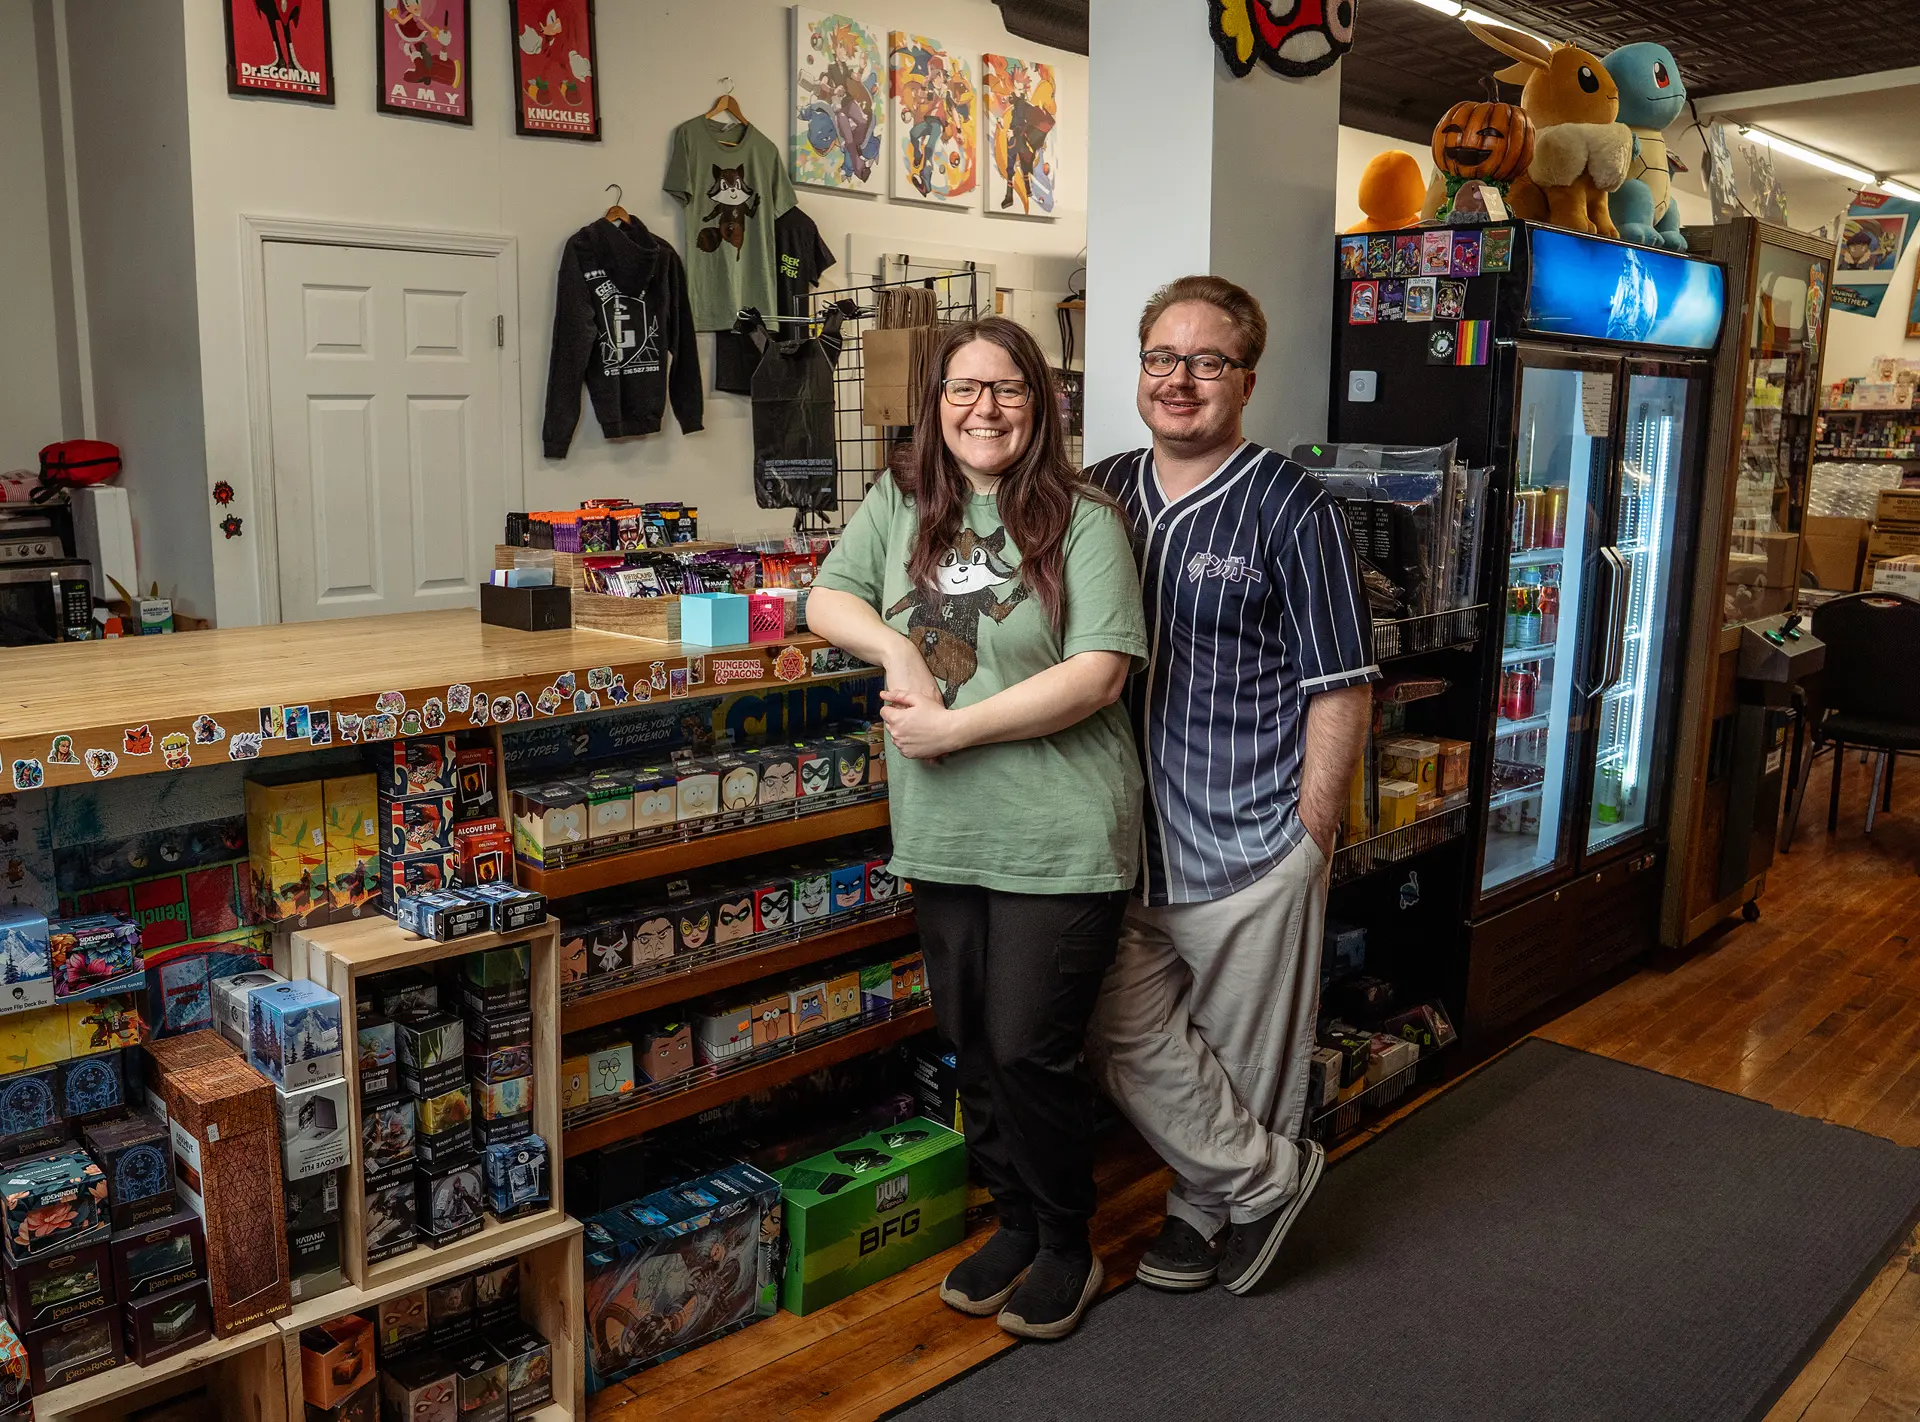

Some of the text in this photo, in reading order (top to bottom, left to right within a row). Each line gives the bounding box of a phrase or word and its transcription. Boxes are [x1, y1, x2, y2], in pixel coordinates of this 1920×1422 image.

[241, 62, 320, 84] Dr.EGGMAN
[242, 78, 320, 92] EVIL GENIUS
[391, 84, 460, 105] AMY
[527, 107, 591, 124] KNUCKLES
[1832, 288, 1857, 299] OURNEY
[1832, 295, 1869, 308] TOGETHER
[713, 660, 761, 671] DUNGEONS
[723, 669, 764, 679] DRAGONS
[609, 715, 677, 737] CHOOSE YOUR
[573, 733, 590, 757] 2
[613, 738, 624, 748] 21
[503, 743, 560, 762] RGY TYPES
[457, 823, 497, 835] ALCOVE FLIP
[134, 902, 188, 930] Bench
[79, 932, 115, 944] SIDEWINDER
[106, 981, 144, 992] ULTIMATE GUARD
[13, 1004, 23, 1012] Flip
[24, 1001, 38, 1009] Deck
[293, 1080, 309, 1088] Alcove
[316, 1075, 327, 1083] Deck
[39, 1136, 61, 1146] RINGS
[299, 1155, 344, 1173] ALCOVE FLIP
[41, 1187, 78, 1201] SIDEWINDER
[876, 1172, 909, 1207] DOOM
[152, 1204, 172, 1214] RINGS
[295, 1231, 326, 1245] KATANA
[859, 1208, 920, 1257] BFG
[149, 1269, 197, 1292] LORD RINGS
[52, 1296, 105, 1320] LORD RINGS
[234, 1303, 287, 1326] ULTIMATE GUARD
[65, 1358, 116, 1382] LORD RINGS
